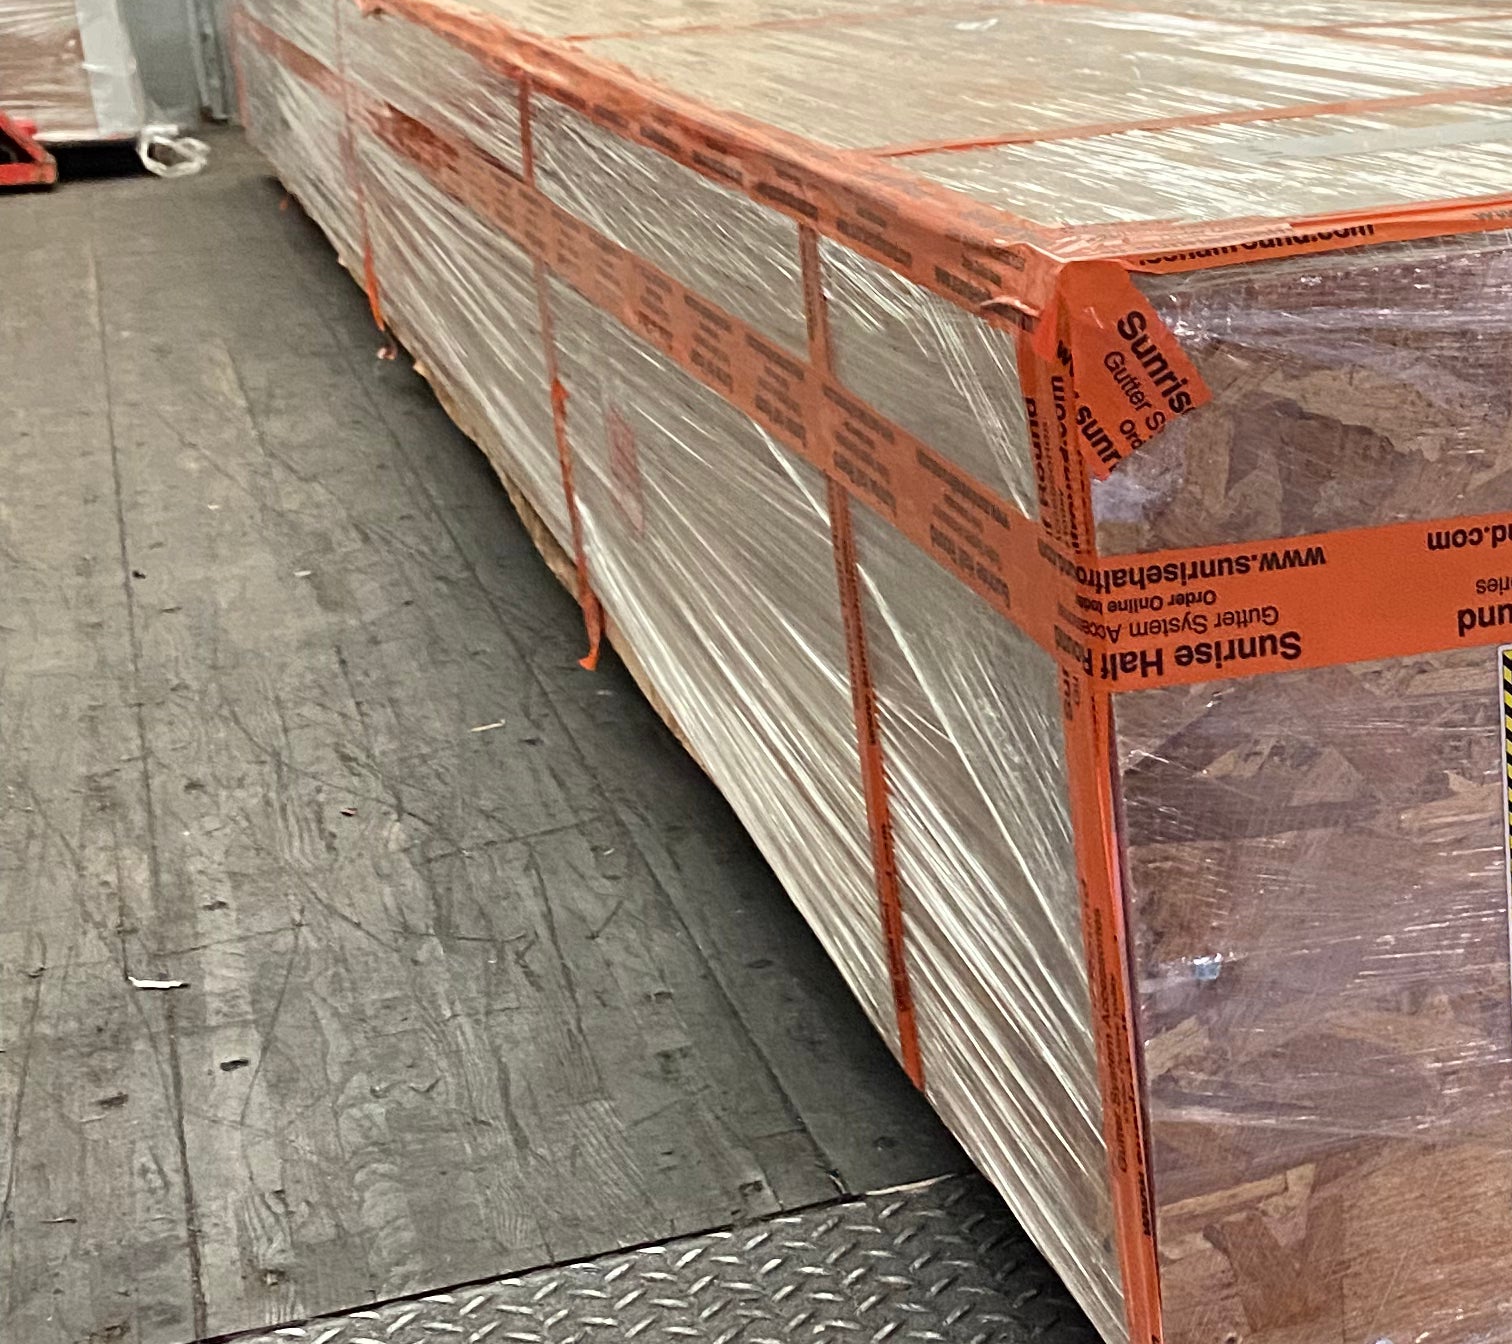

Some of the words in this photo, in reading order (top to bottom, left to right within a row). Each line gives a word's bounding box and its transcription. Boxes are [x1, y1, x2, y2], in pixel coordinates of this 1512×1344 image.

[1117, 311, 1196, 415] Sunris
[1104, 351, 1153, 411] Gutter
[1108, 595, 1164, 614] Online
[1167, 589, 1217, 607] Order
[1129, 611, 1208, 639] System
[1213, 605, 1279, 629] Gutter
[1100, 648, 1164, 681] Half
[1174, 631, 1302, 669] Sunrise
